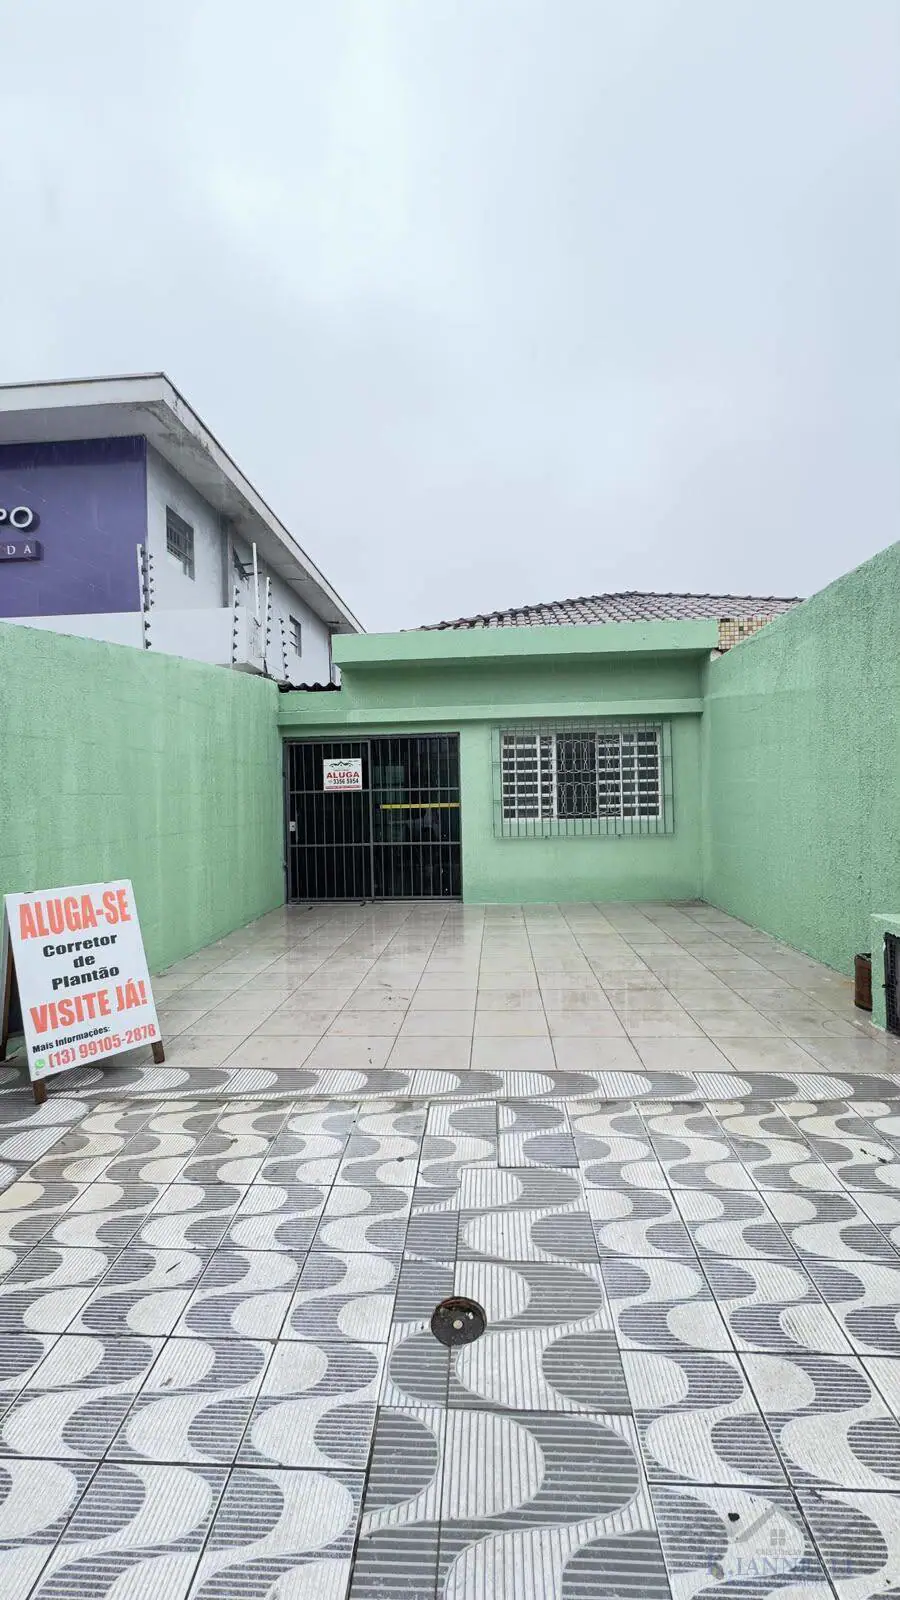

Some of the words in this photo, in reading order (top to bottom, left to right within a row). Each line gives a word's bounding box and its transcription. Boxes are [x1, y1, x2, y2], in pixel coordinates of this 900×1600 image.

[19, 889, 131, 940] ALUGA-SE
[43, 934, 118, 957] Corretor
[73, 955, 96, 968] de
[52, 966, 120, 990] Plantão
[30, 989, 112, 1034] VISITE
[116, 978, 148, 1012] JÁ!
[32, 1041, 54, 1053] Mais
[55, 1025, 111, 1046] Informações:
[48, 1047, 76, 1068] (13)
[79, 1023, 156, 1058] 99105-2878
